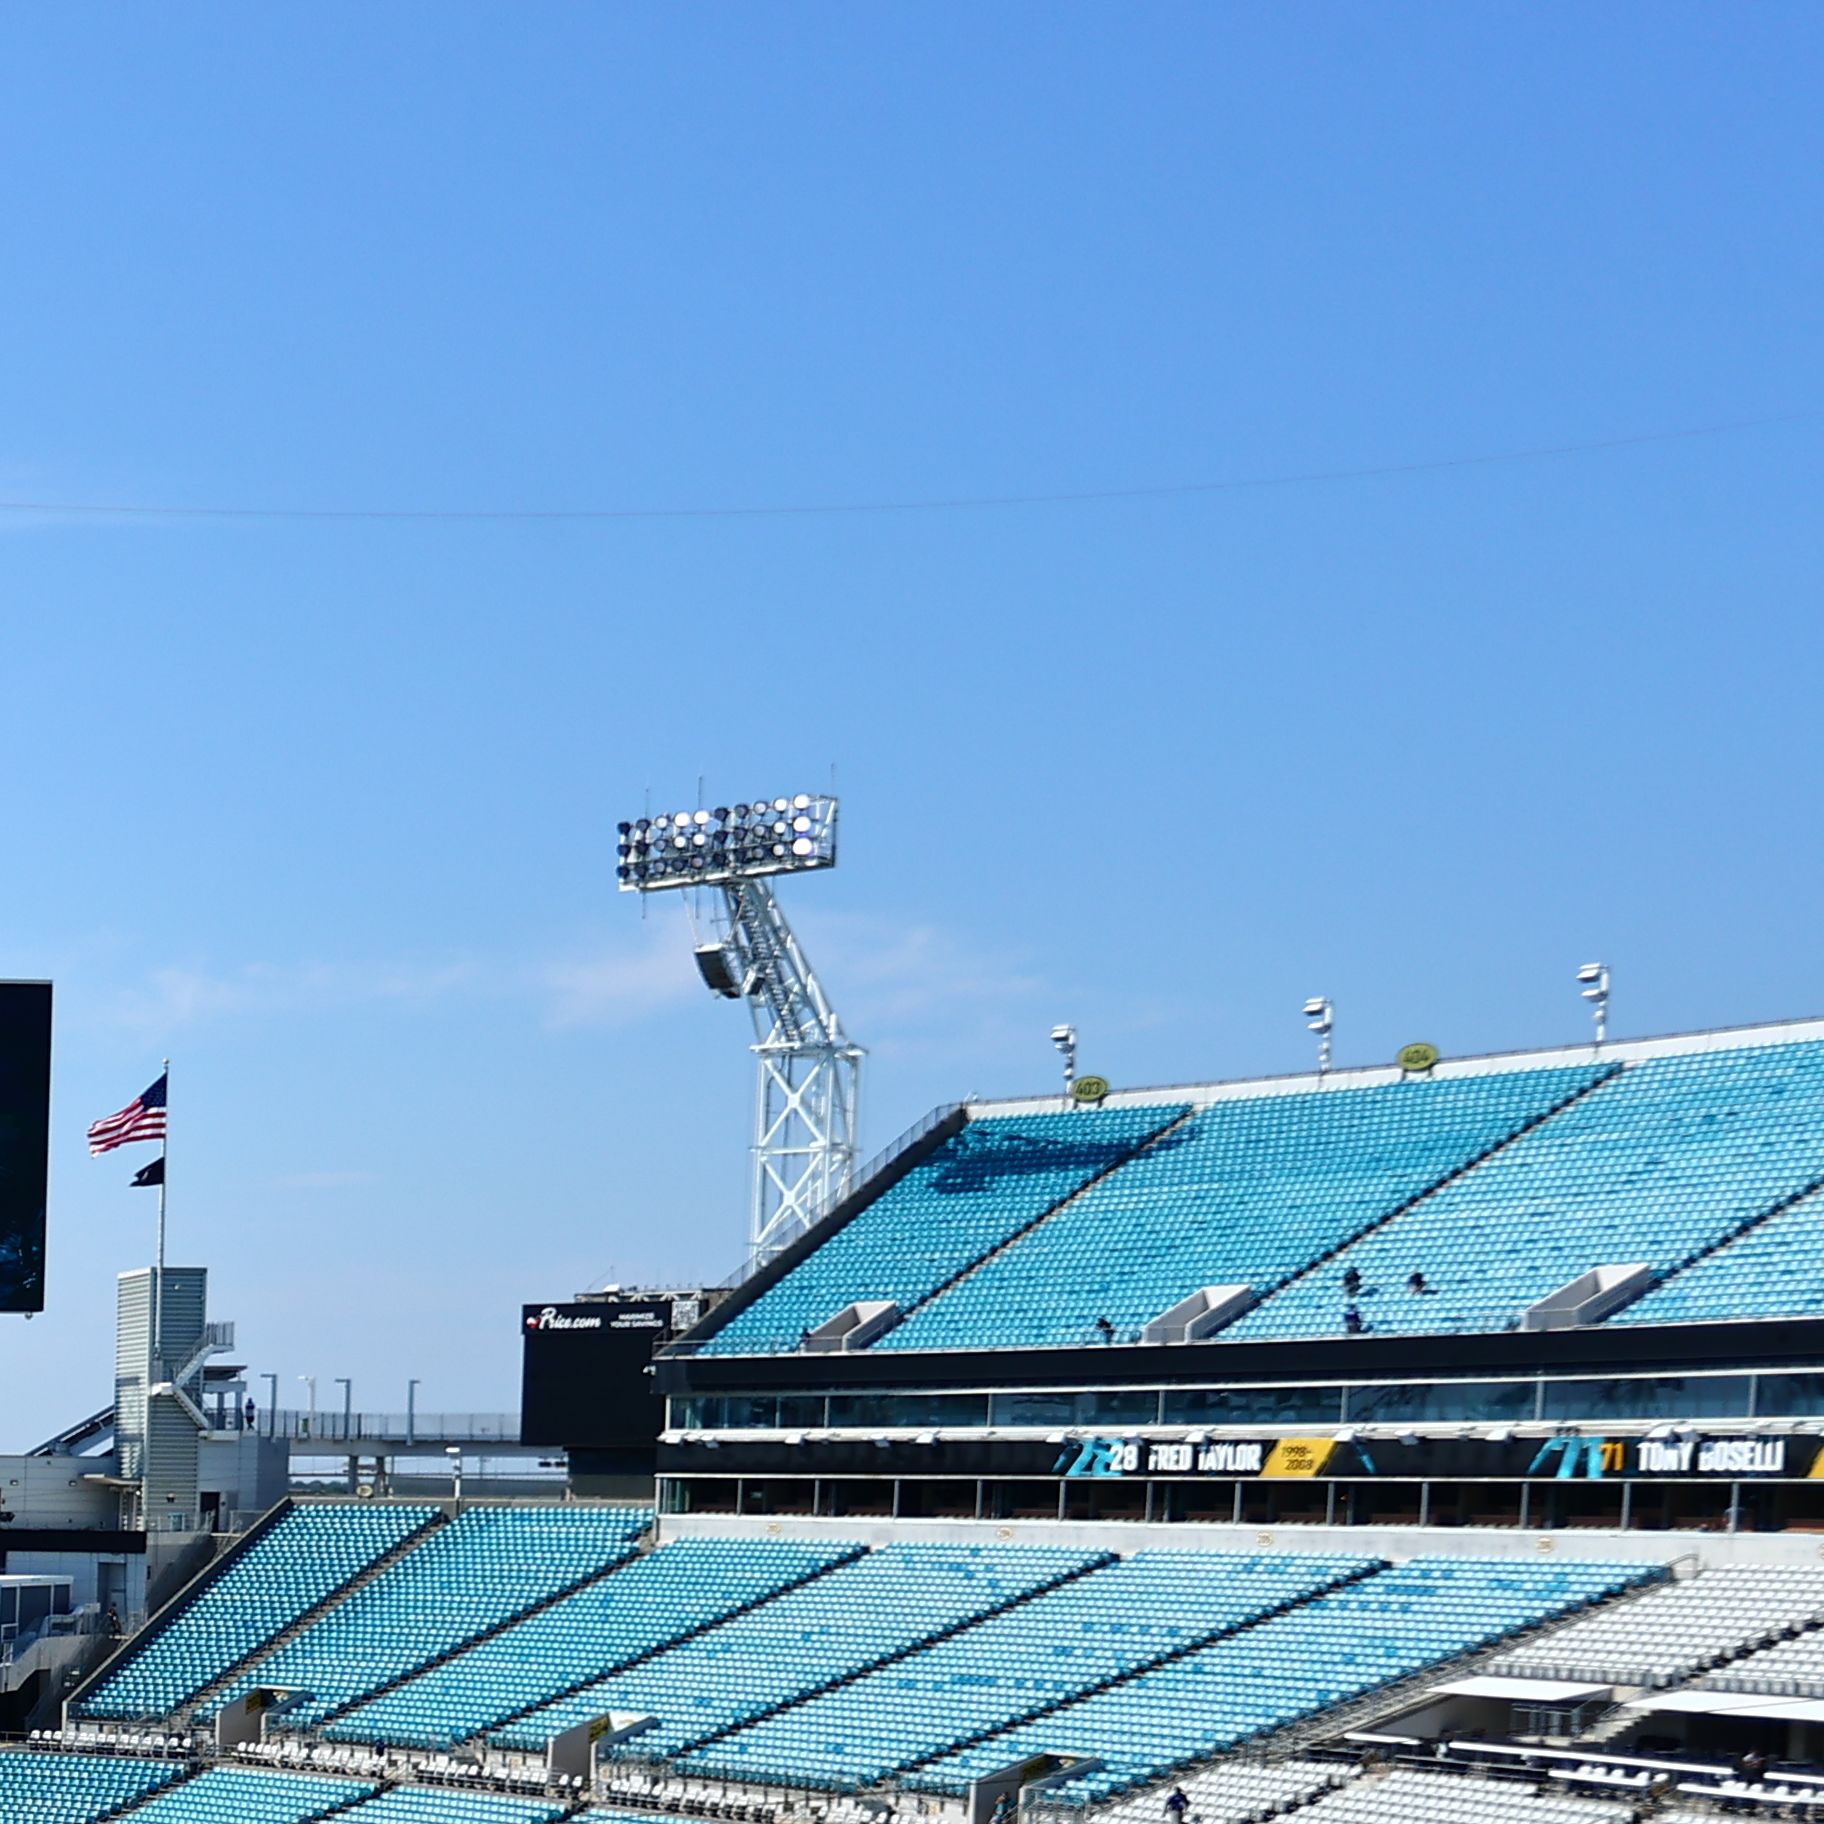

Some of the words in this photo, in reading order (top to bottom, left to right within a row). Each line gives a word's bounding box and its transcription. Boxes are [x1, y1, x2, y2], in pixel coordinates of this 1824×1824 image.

[538, 1307, 601, 1330] Price.com
[1110, 1444, 1139, 1470] 28
[1148, 1444, 1191, 1471] FRED
[1198, 1443, 1263, 1471] TAYLOR
[1601, 1442, 1624, 1471] 71
[1638, 1442, 1694, 1471] TONY
[1697, 1441, 1784, 1471] BOSELLI
